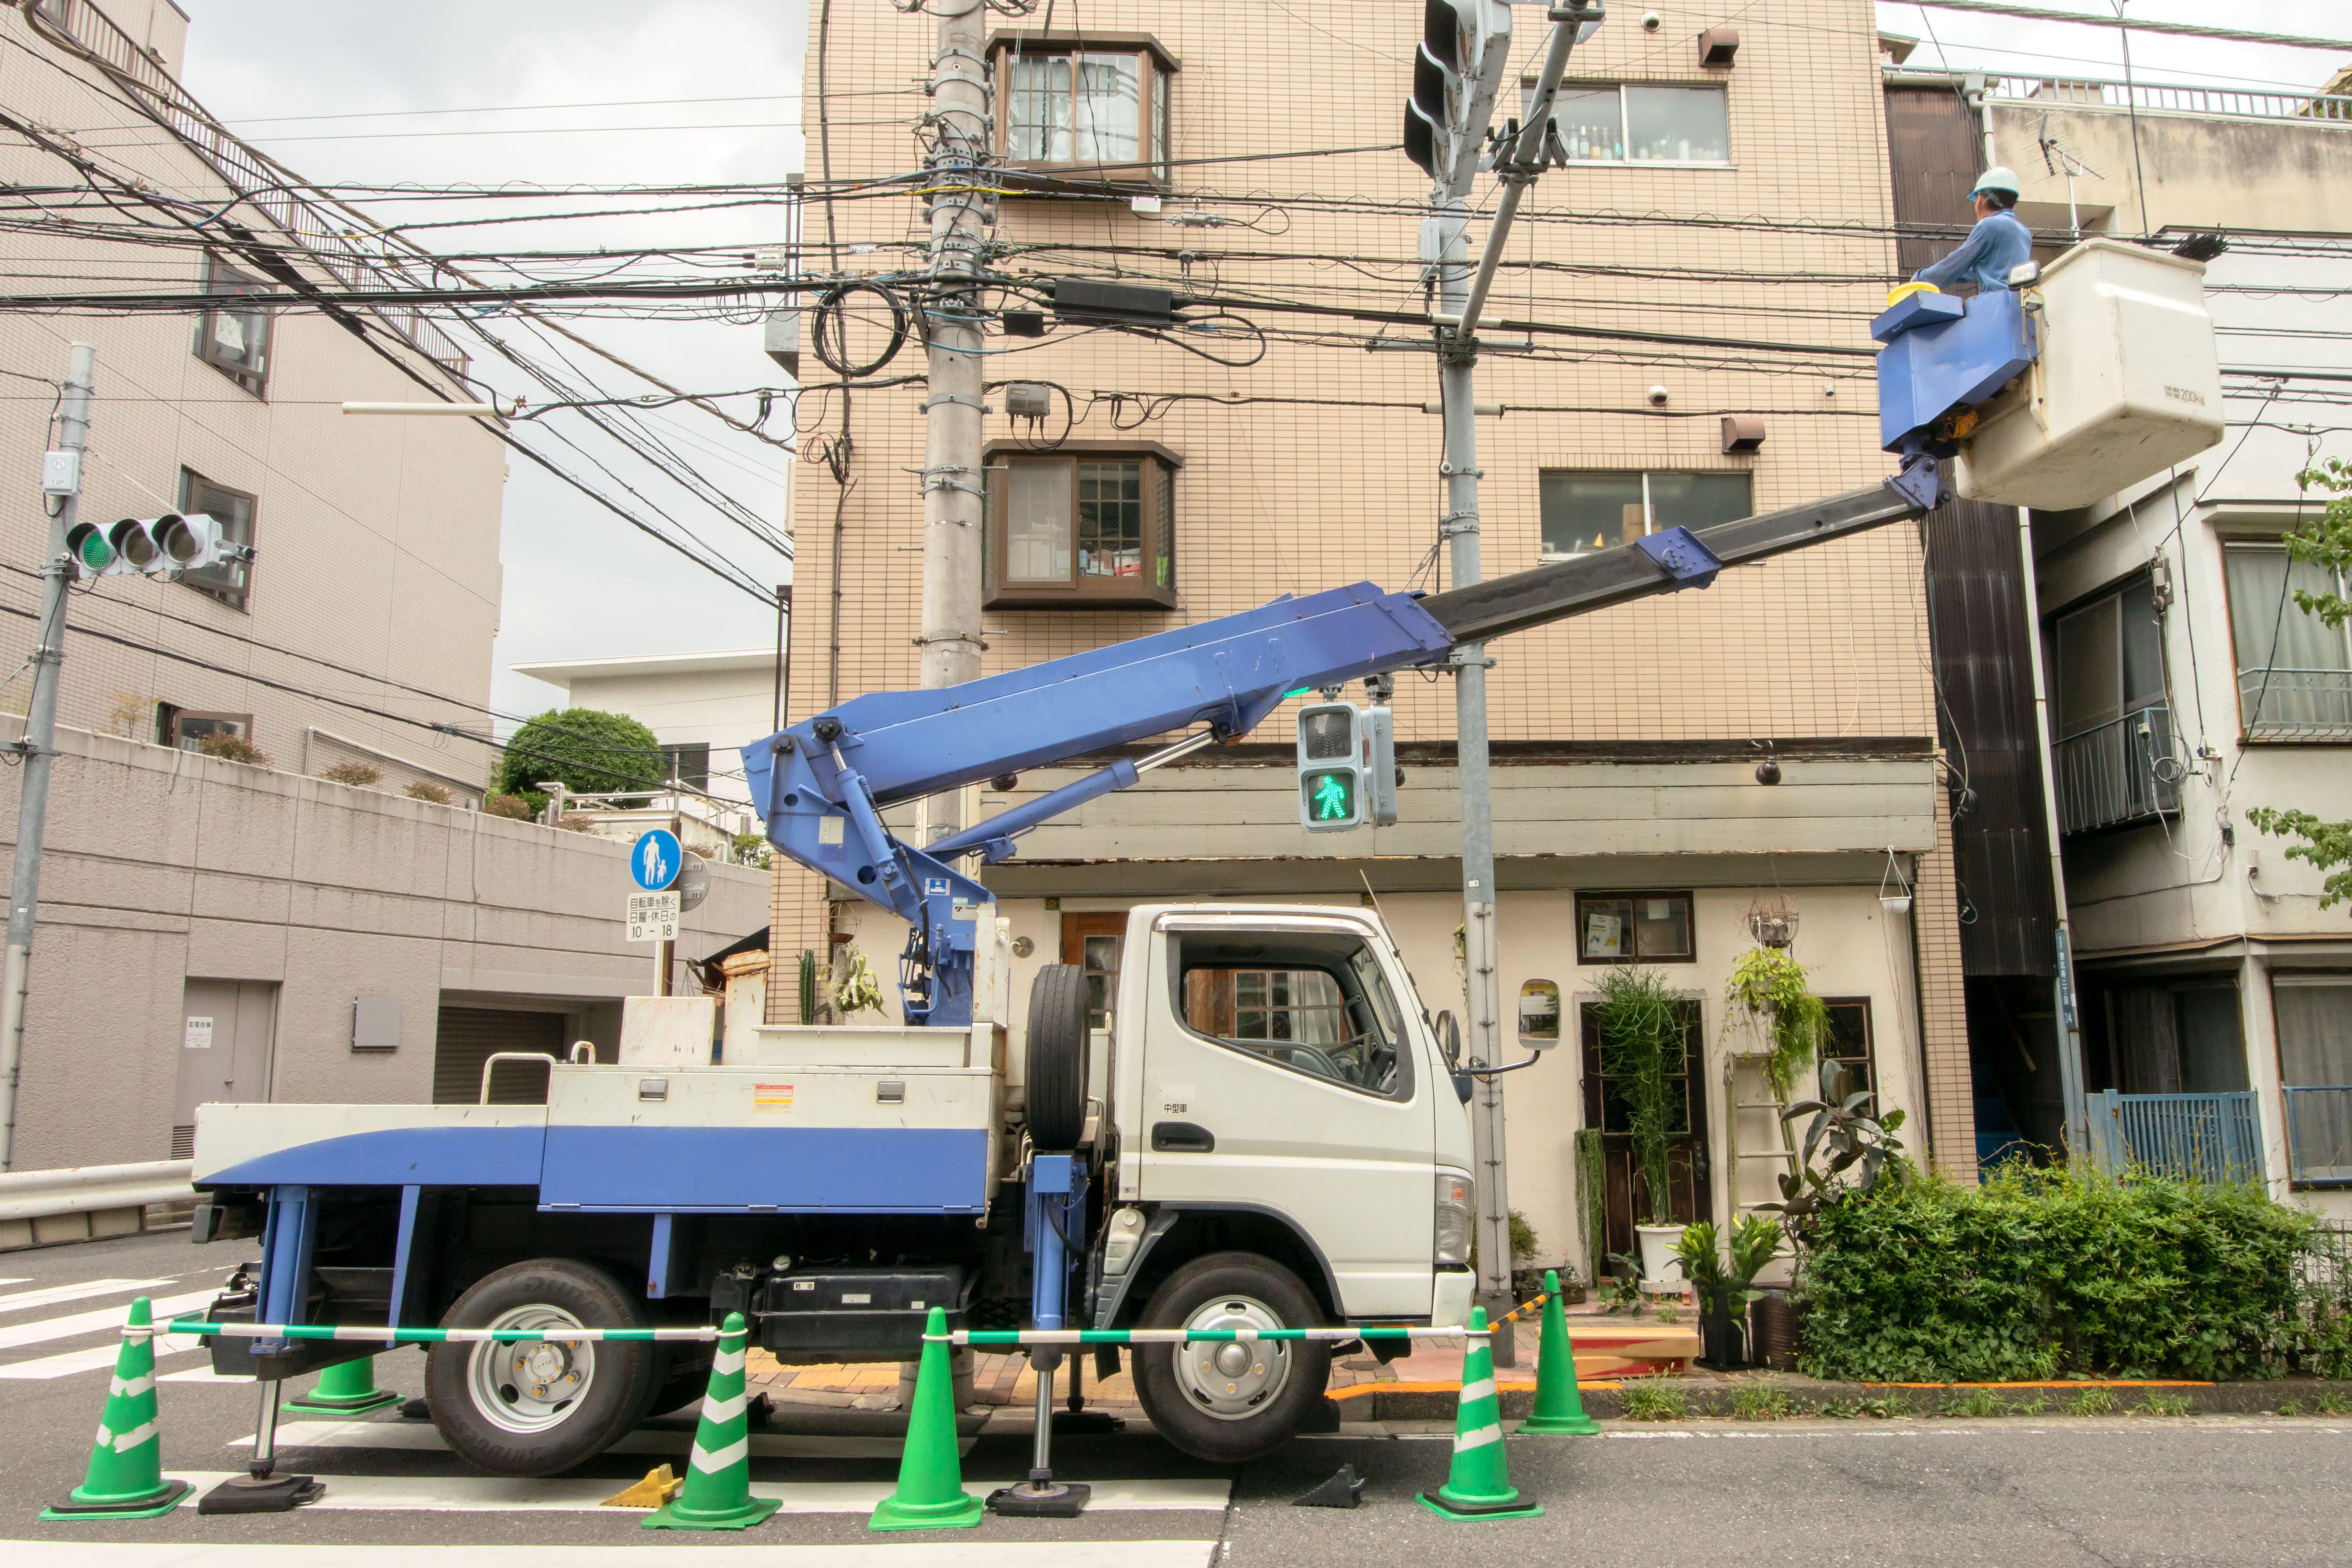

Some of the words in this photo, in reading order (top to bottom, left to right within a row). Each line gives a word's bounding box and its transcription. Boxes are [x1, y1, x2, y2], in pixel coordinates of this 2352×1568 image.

[2180, 389, 2205, 406] 200kg
[630, 896, 676, 909] 自転車を除く
[630, 911, 676, 923] 日曜・休日の
[633, 926, 641, 938] 10
[663, 925, 672, 936] 18
[2065, 1013, 2072, 1023] 24
[1164, 1103, 1187, 1113] 中型車
